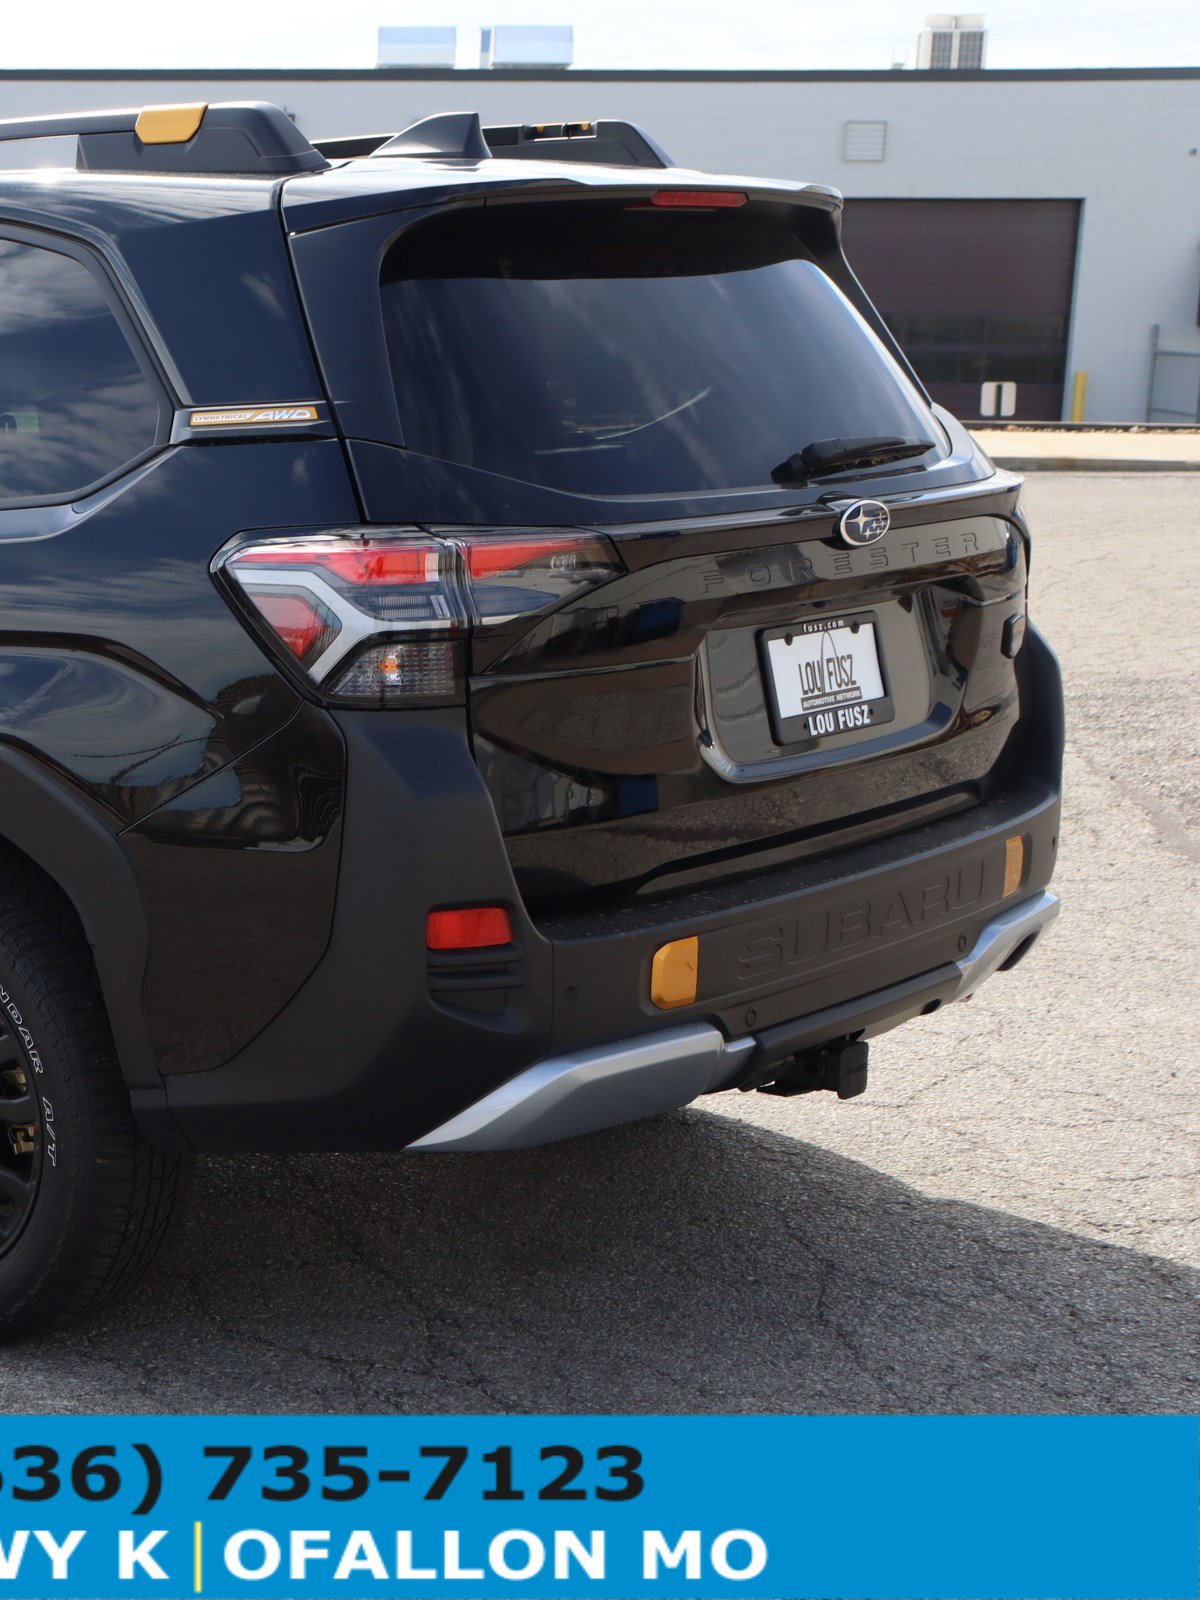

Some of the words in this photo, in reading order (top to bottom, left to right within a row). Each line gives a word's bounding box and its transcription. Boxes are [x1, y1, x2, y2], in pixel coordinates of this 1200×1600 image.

[252, 409, 311, 421] AWD
[702, 532, 979, 593] FORESTER
[802, 620, 844, 632] fusz.com
[798, 660, 824, 695] LOU
[826, 653, 857, 690] FUSZ
[802, 695, 836, 708] AUTOMOTIVE
[836, 689, 862, 702] NETWORK
[807, 713, 835, 736] LOU
[837, 705, 871, 729] FUSZ
[736, 859, 985, 981] SUBARU
[42, 1096, 59, 1167] A/T
